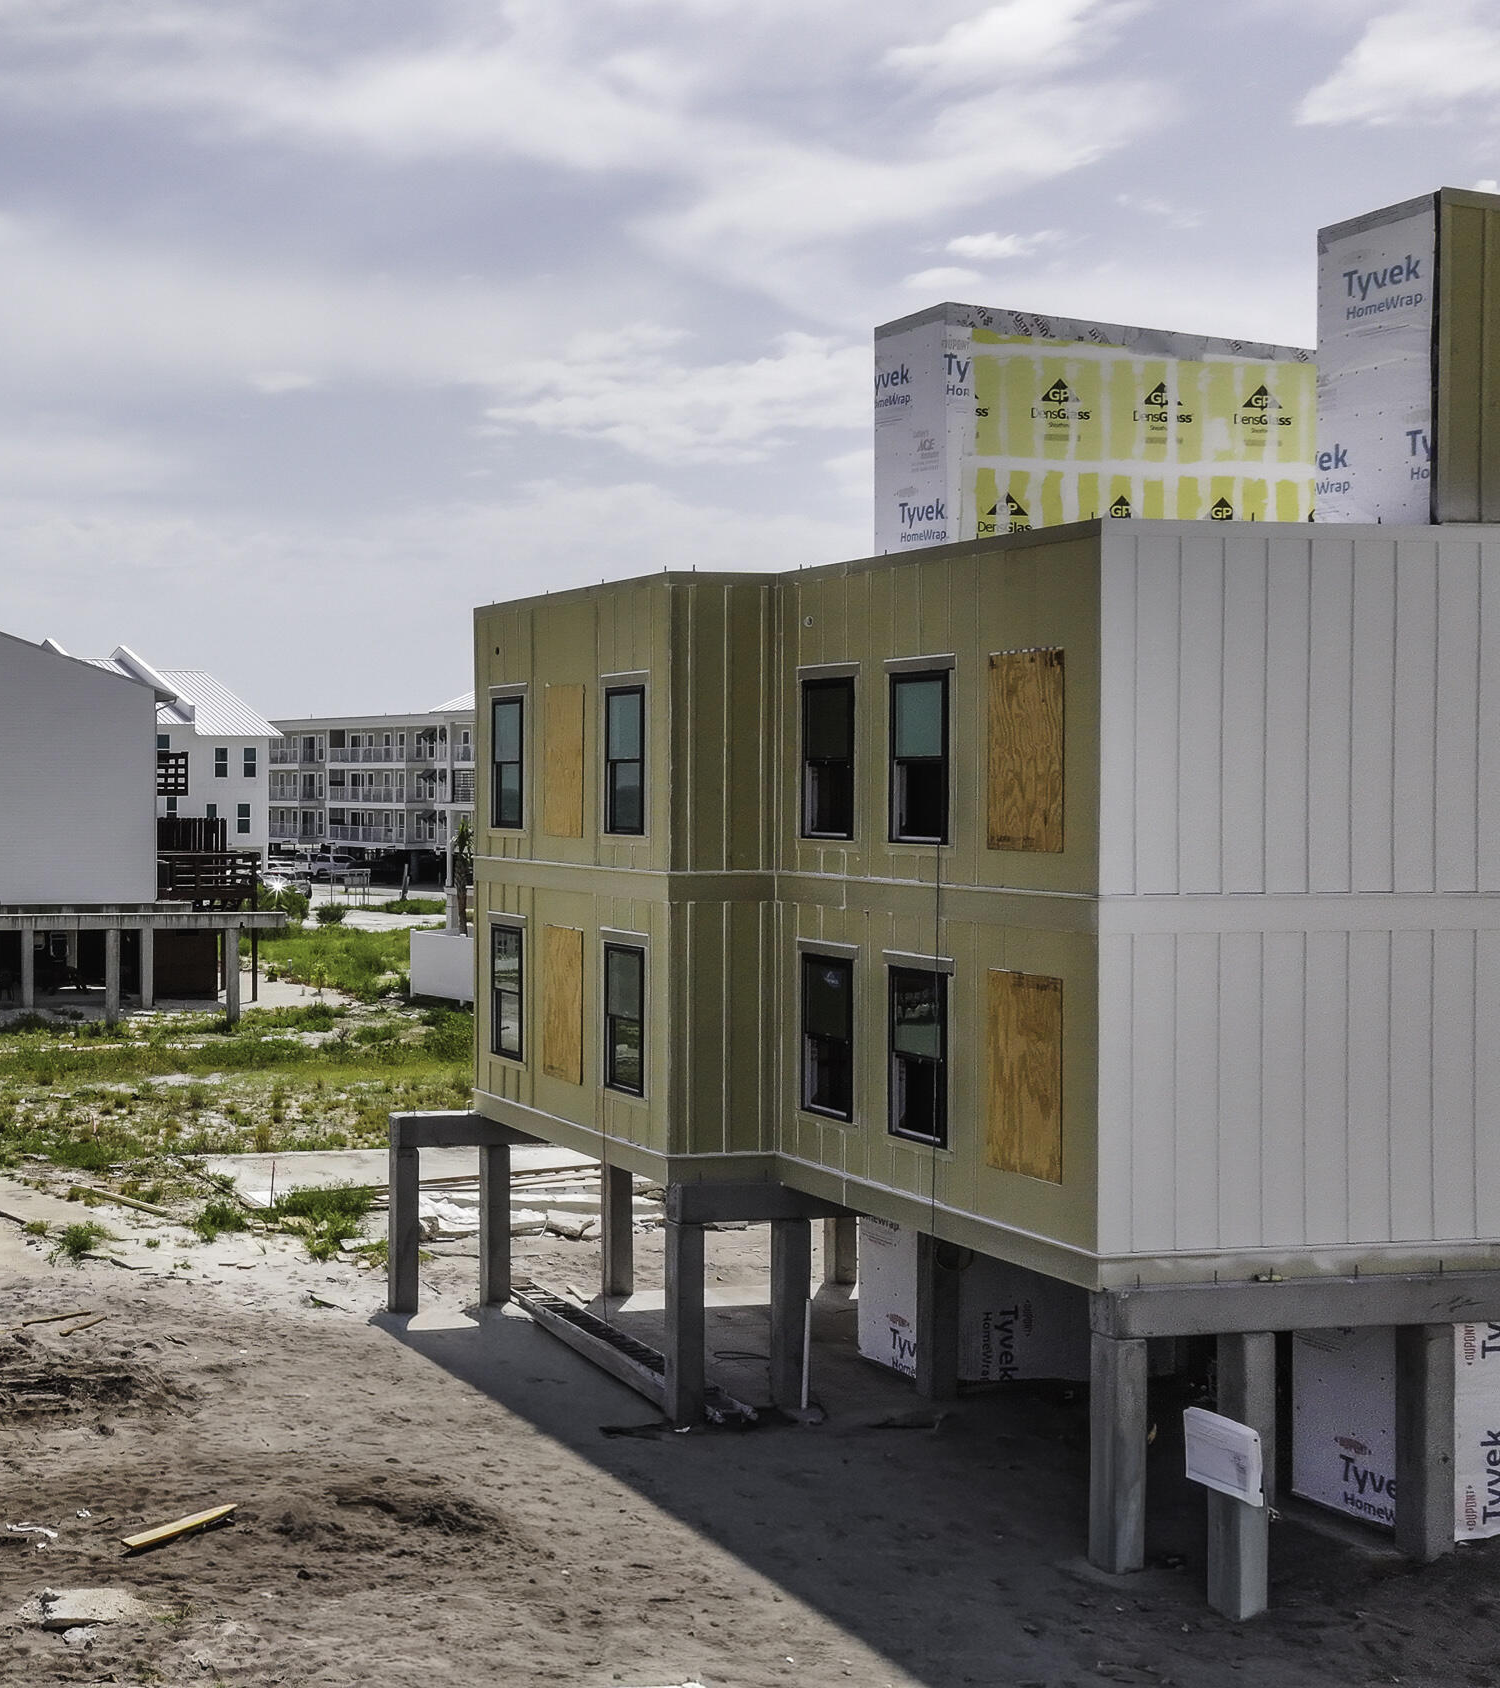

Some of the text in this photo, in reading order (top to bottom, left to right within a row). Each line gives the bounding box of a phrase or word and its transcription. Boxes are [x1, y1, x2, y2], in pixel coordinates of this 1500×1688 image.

[1342, 254, 1420, 301] Tyvek
[1346, 292, 1423, 320] HomeWrap
[1315, 443, 1348, 472] ek
[899, 498, 946, 530] Tyvek
[1211, 507, 1232, 519] GP
[900, 528, 947, 543] HomeWrap
[994, 1305, 1019, 1380] Tyvek
